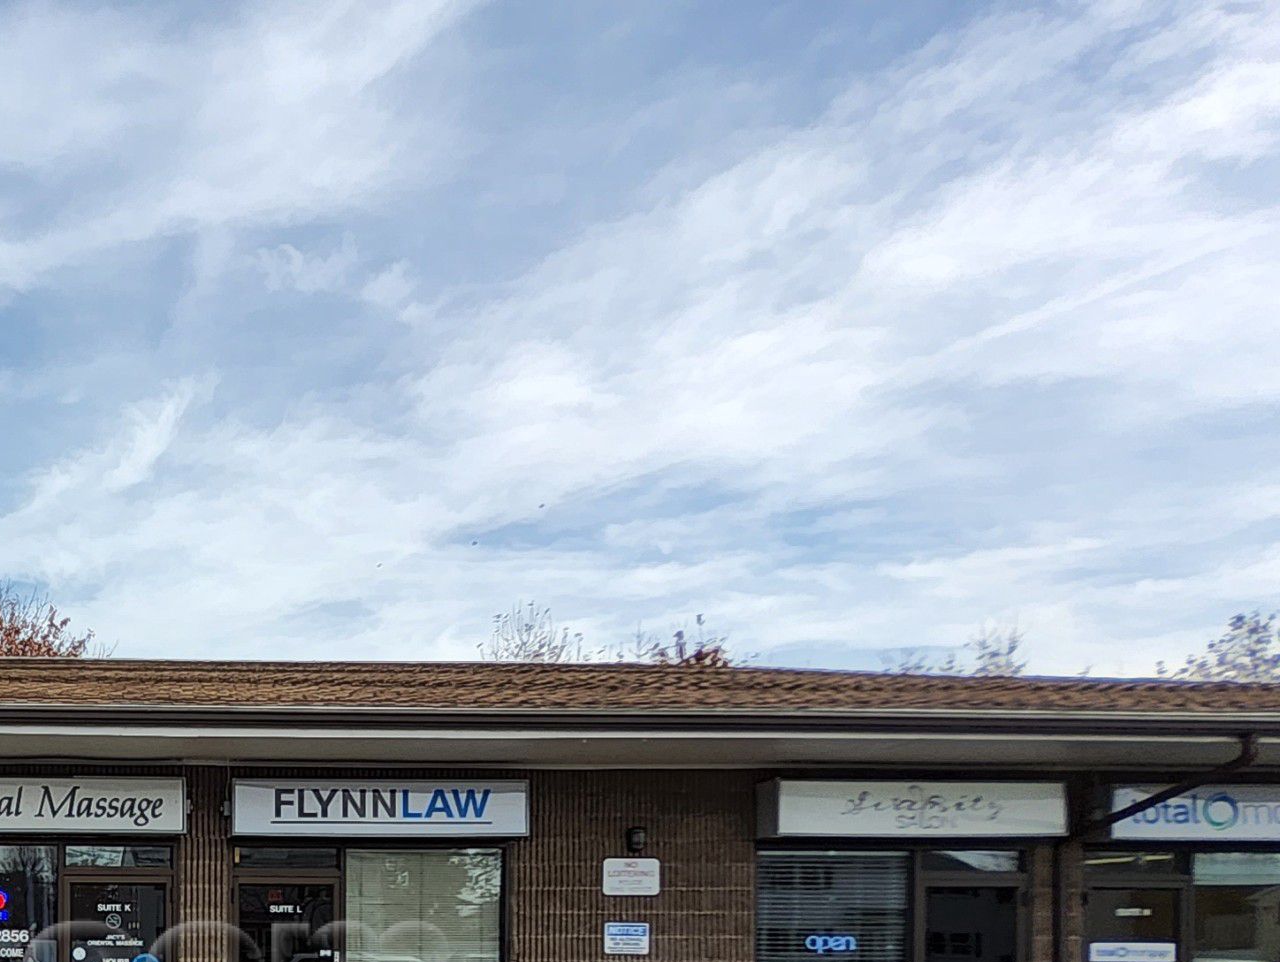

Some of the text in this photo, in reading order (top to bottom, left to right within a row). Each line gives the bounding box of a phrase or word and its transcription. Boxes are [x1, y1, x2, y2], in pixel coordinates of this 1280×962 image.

[34, 785, 164, 827] Massage
[97, 904, 131, 912] SUITE K
[269, 905, 303, 913] SUITE L
[805, 935, 858, 954] open
